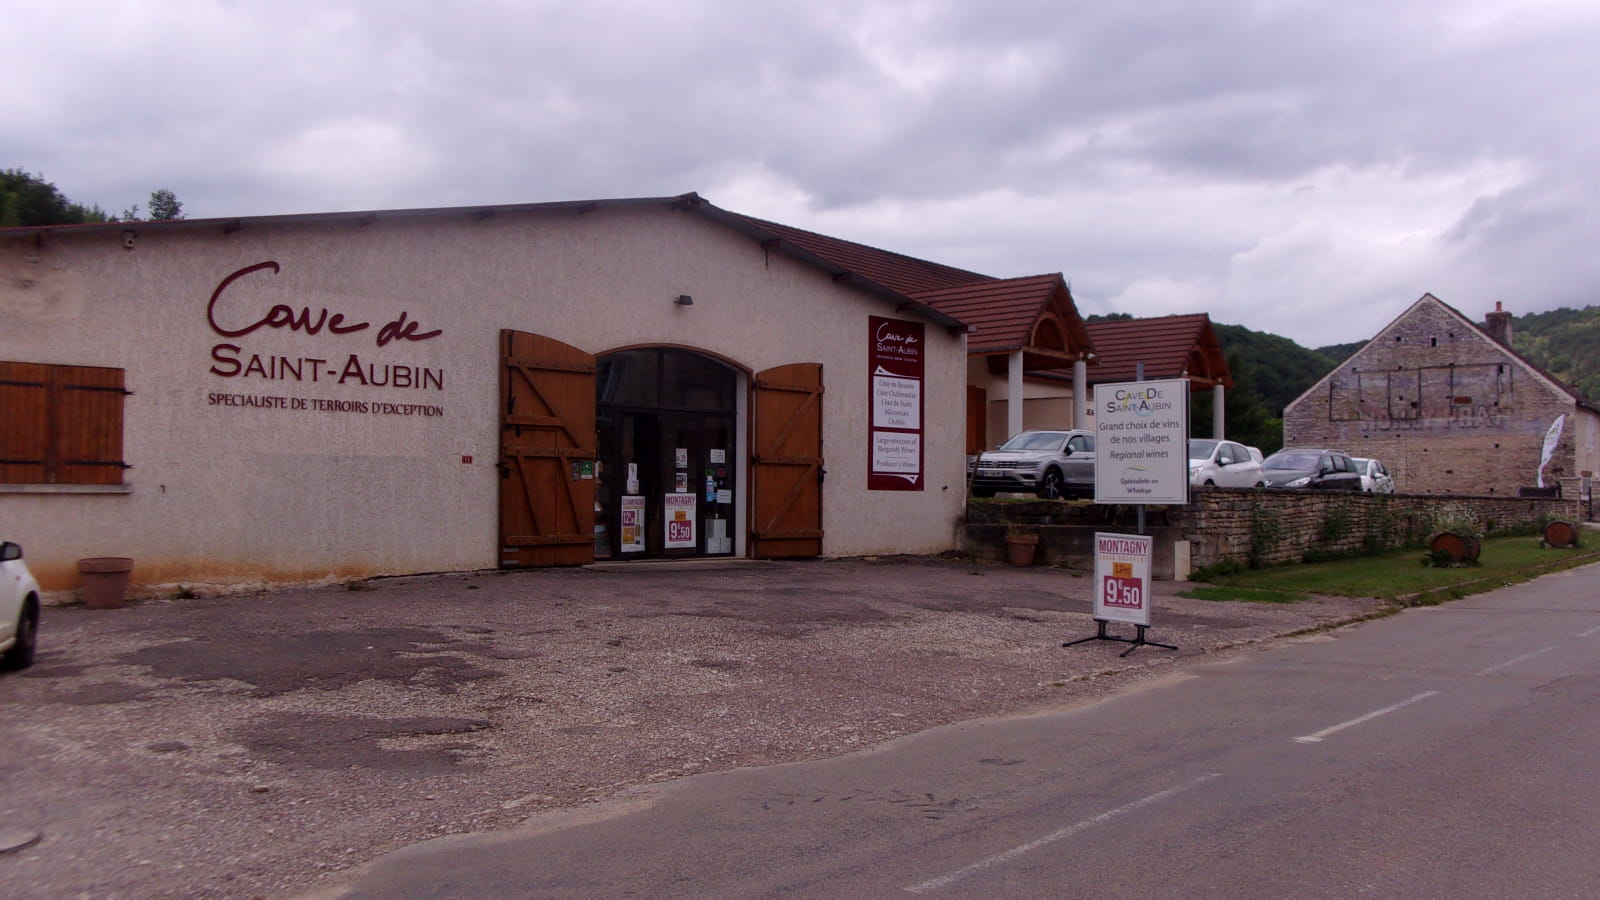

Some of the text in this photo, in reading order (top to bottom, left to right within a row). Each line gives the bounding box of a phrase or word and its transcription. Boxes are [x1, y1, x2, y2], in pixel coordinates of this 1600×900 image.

[207, 261, 443, 347] Cave de
[876, 321, 905, 342] Cave
[209, 343, 444, 390] SAINT-AUBIN
[1115, 389, 1145, 401] CAVE
[208, 392, 444, 417] SPECIALISTE DE TERROIRS D'EXCEPTION
[1106, 400, 1172, 413] SAINT-AUBIN
[1099, 419, 1180, 431] Grand choix de vins
[1110, 433, 1170, 444] de nos villages
[1110, 450, 1169, 461] Regional wines
[666, 495, 696, 505] MONTAGNY
[1098, 539, 1149, 554] MONTAGNY
